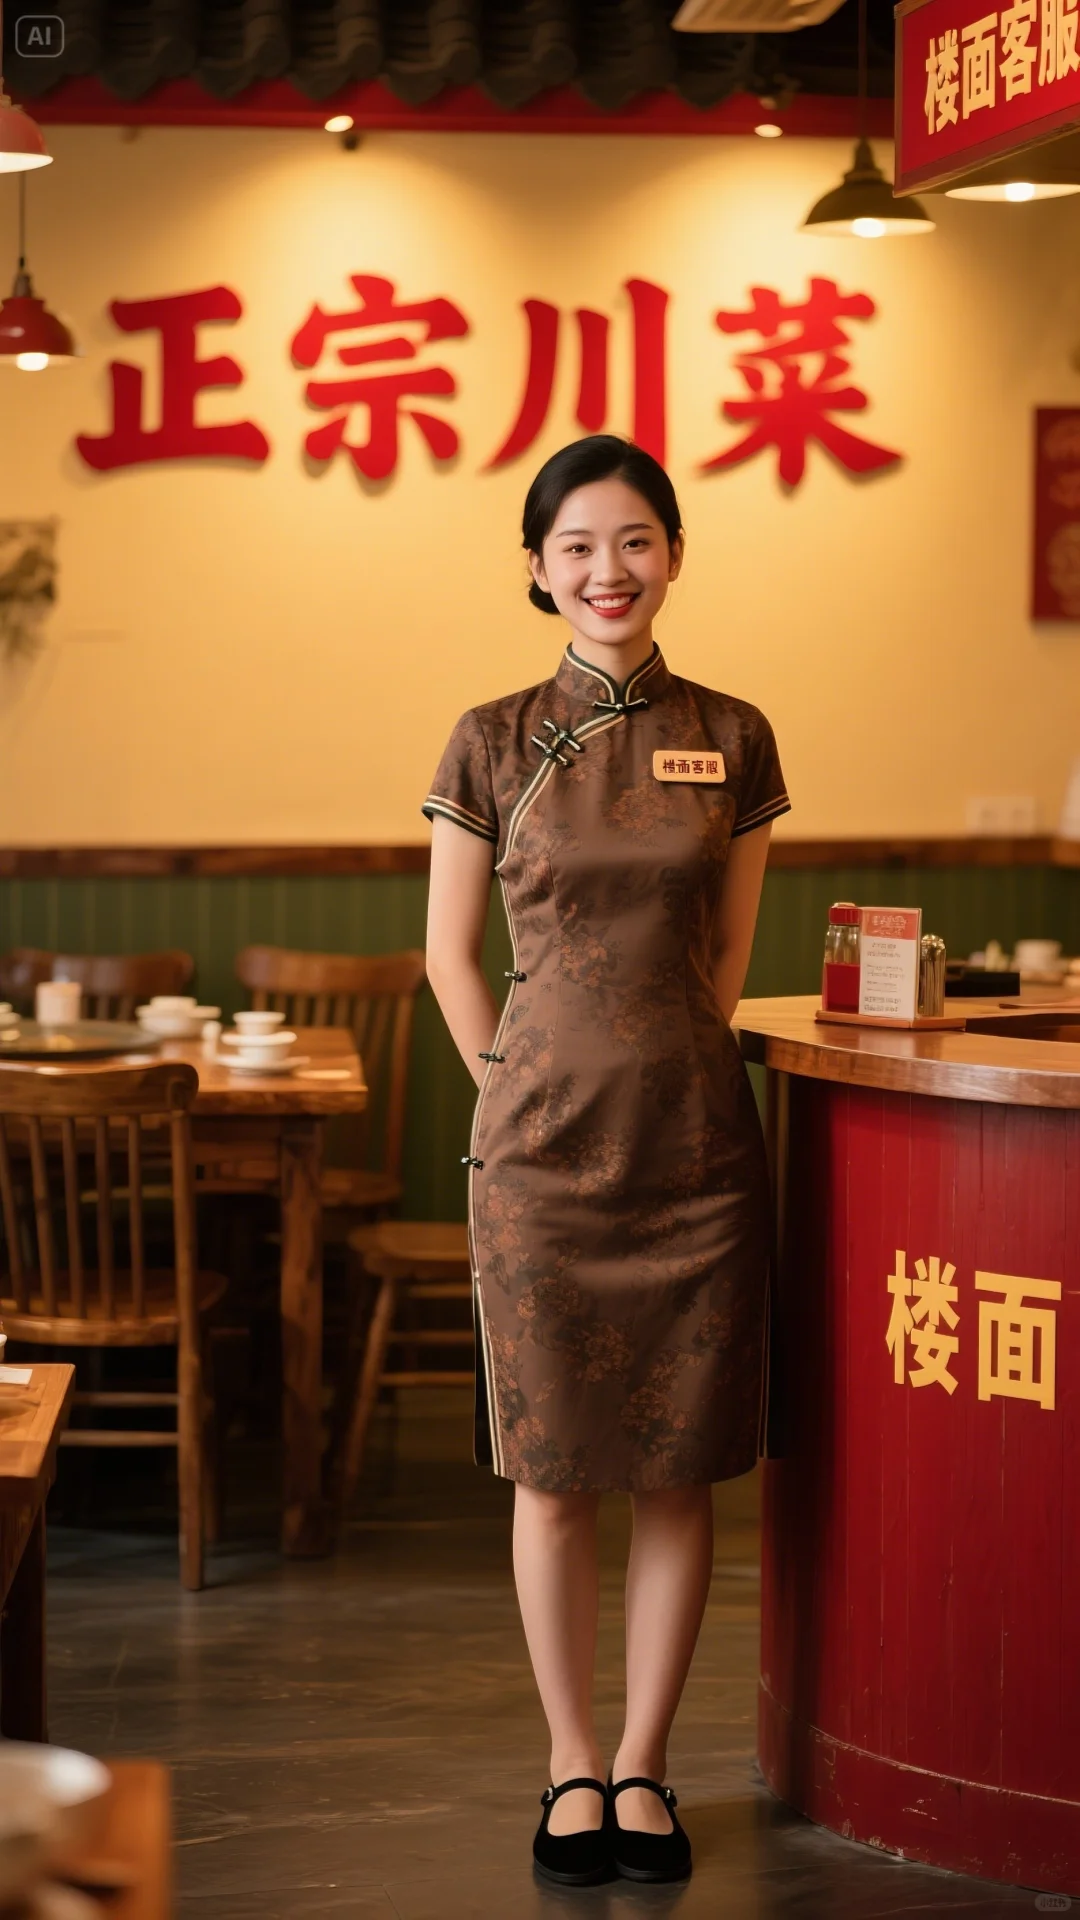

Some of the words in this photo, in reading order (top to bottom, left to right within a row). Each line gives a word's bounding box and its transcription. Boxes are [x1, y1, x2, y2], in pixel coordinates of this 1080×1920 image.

[924, 0, 1080, 136] 楼面客服
[76, 275, 904, 487] 正宗川菜
[885, 1249, 1062, 1411] 楼面
